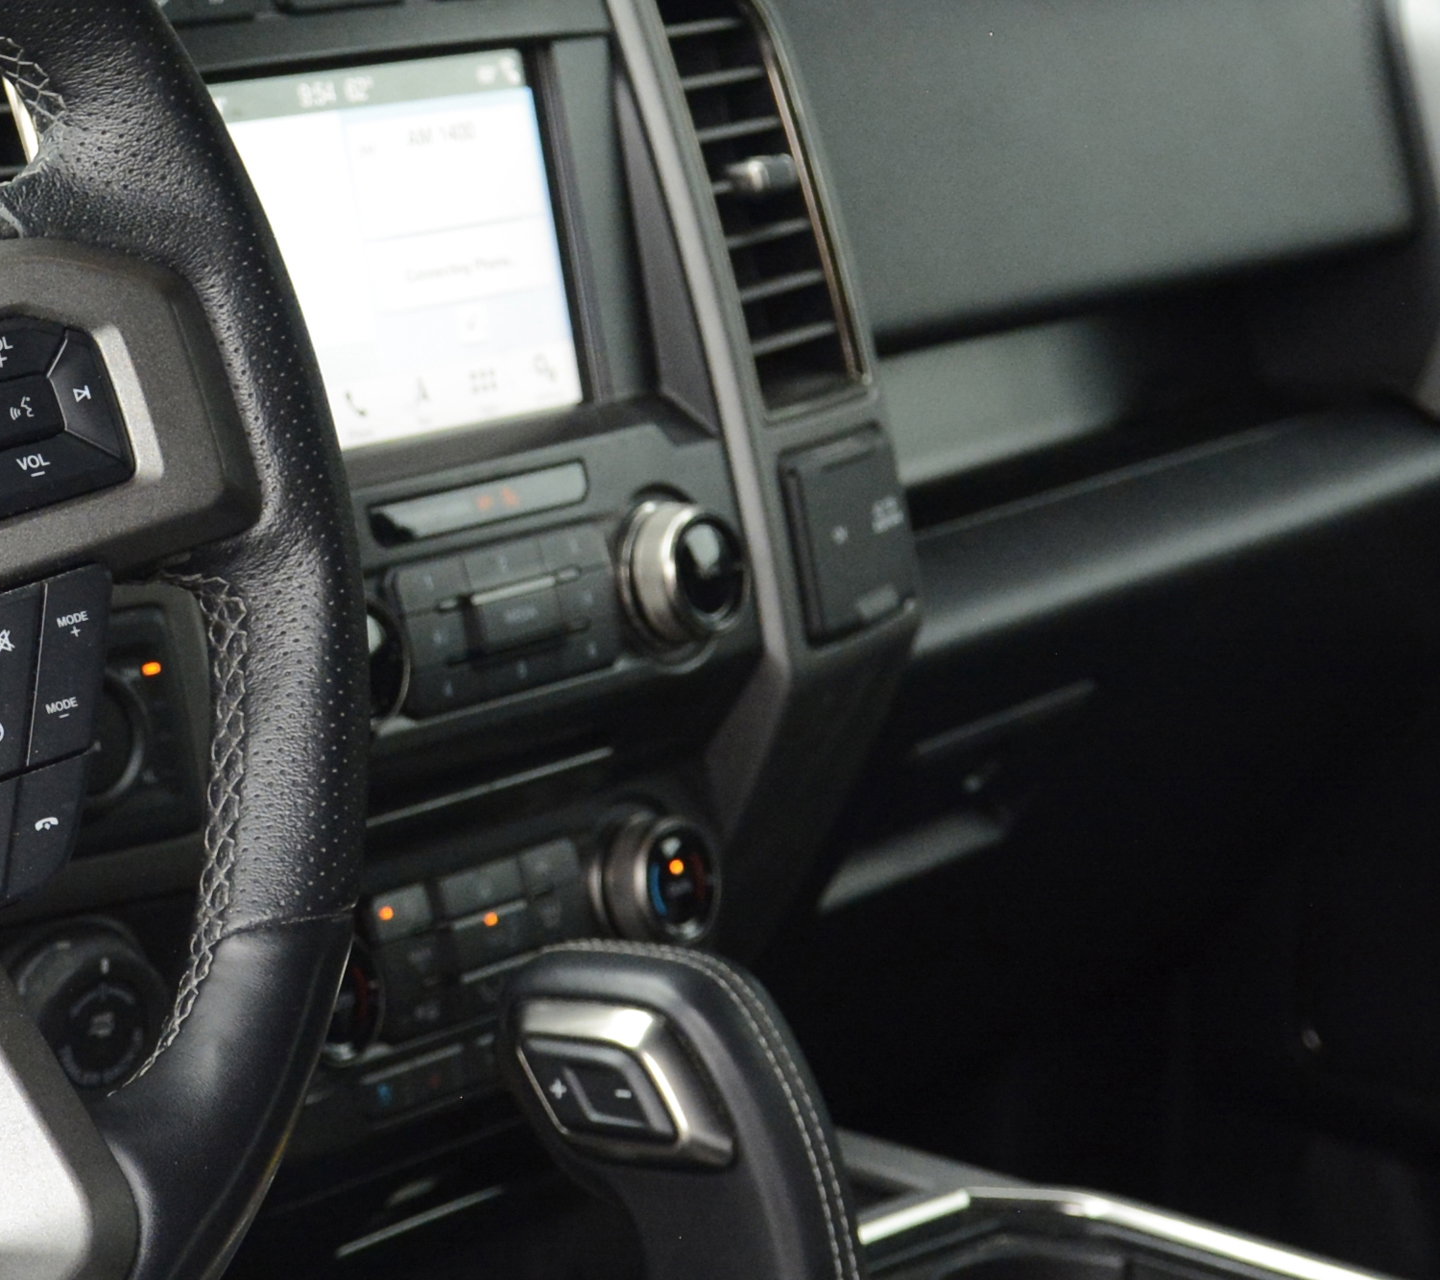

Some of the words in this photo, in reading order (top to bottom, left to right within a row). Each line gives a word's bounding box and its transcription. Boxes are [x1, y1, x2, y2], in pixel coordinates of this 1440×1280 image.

[16, 452, 50, 471] VOL
[56, 609, 89, 629] MODE
[45, 696, 79, 715] MODE
